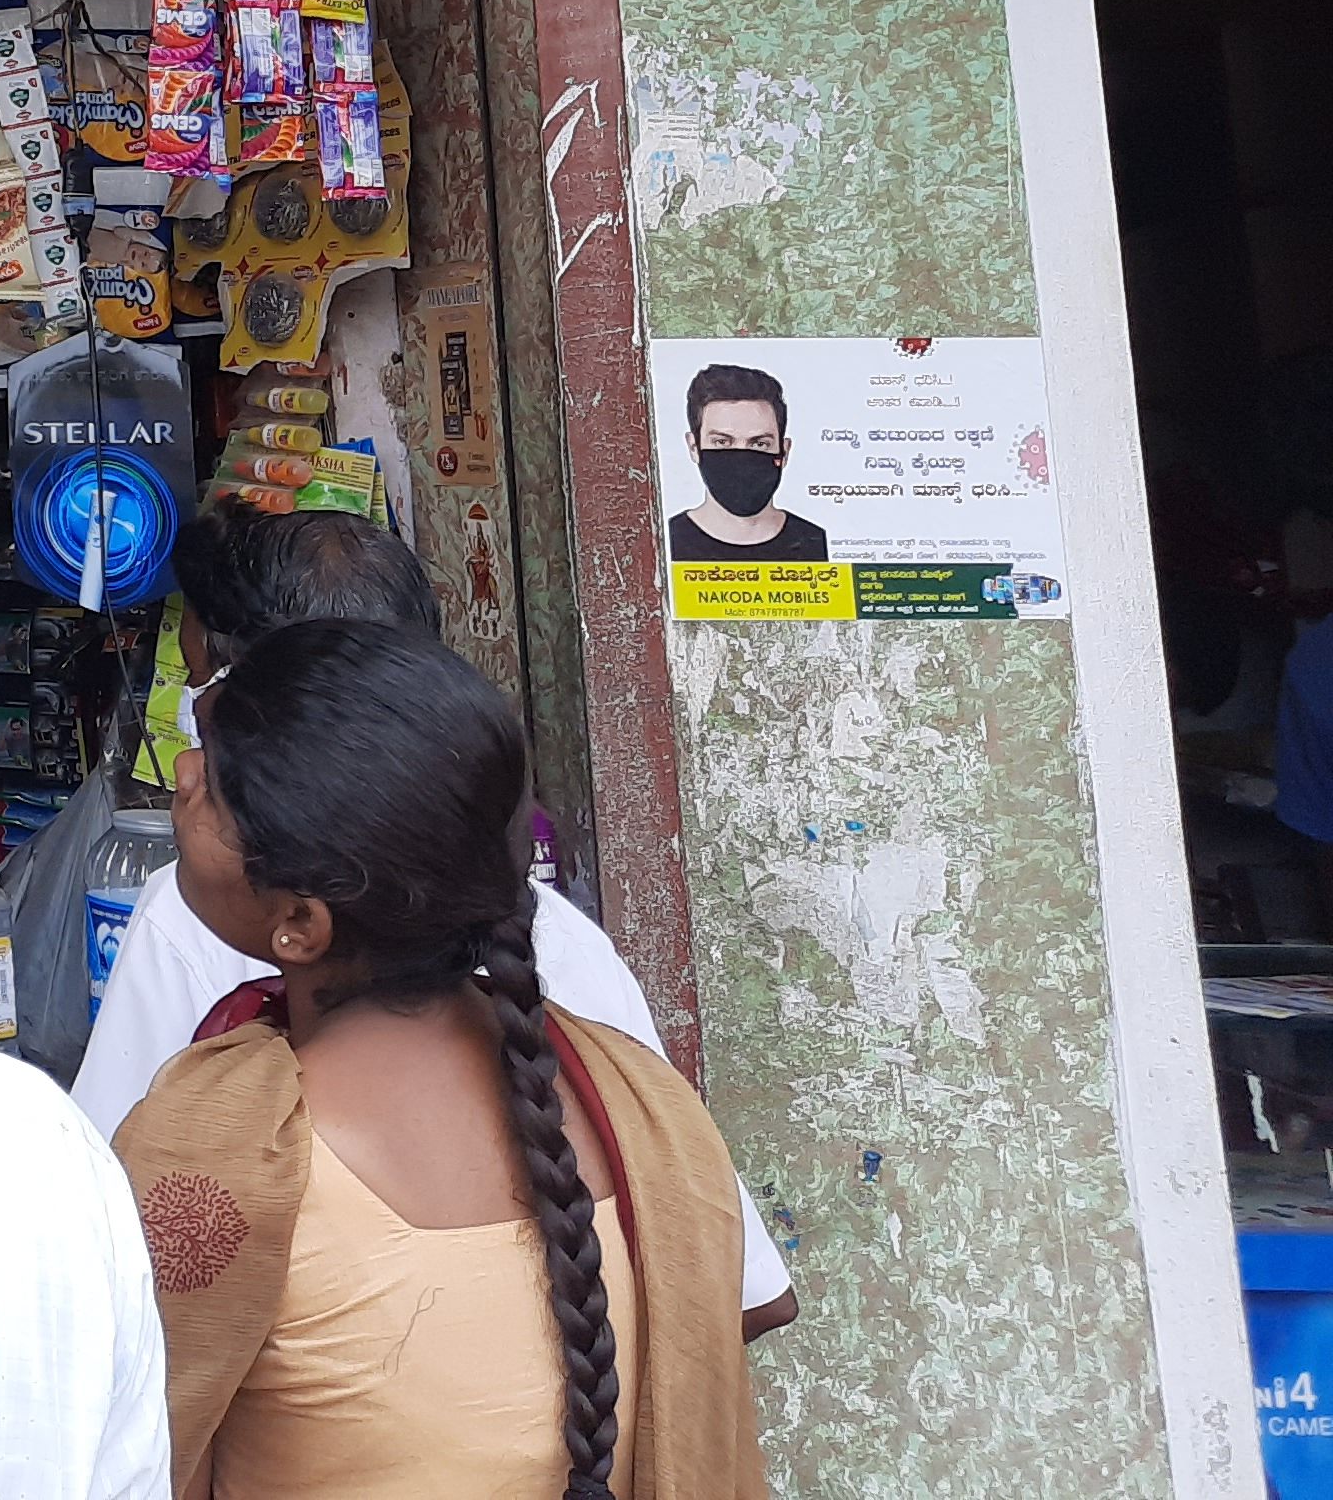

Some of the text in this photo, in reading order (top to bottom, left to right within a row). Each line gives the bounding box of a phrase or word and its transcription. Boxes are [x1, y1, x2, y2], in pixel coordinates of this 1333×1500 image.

[22, 420, 175, 445] STELLAR
[698, 591, 829, 603] NAKODA MOBILES
